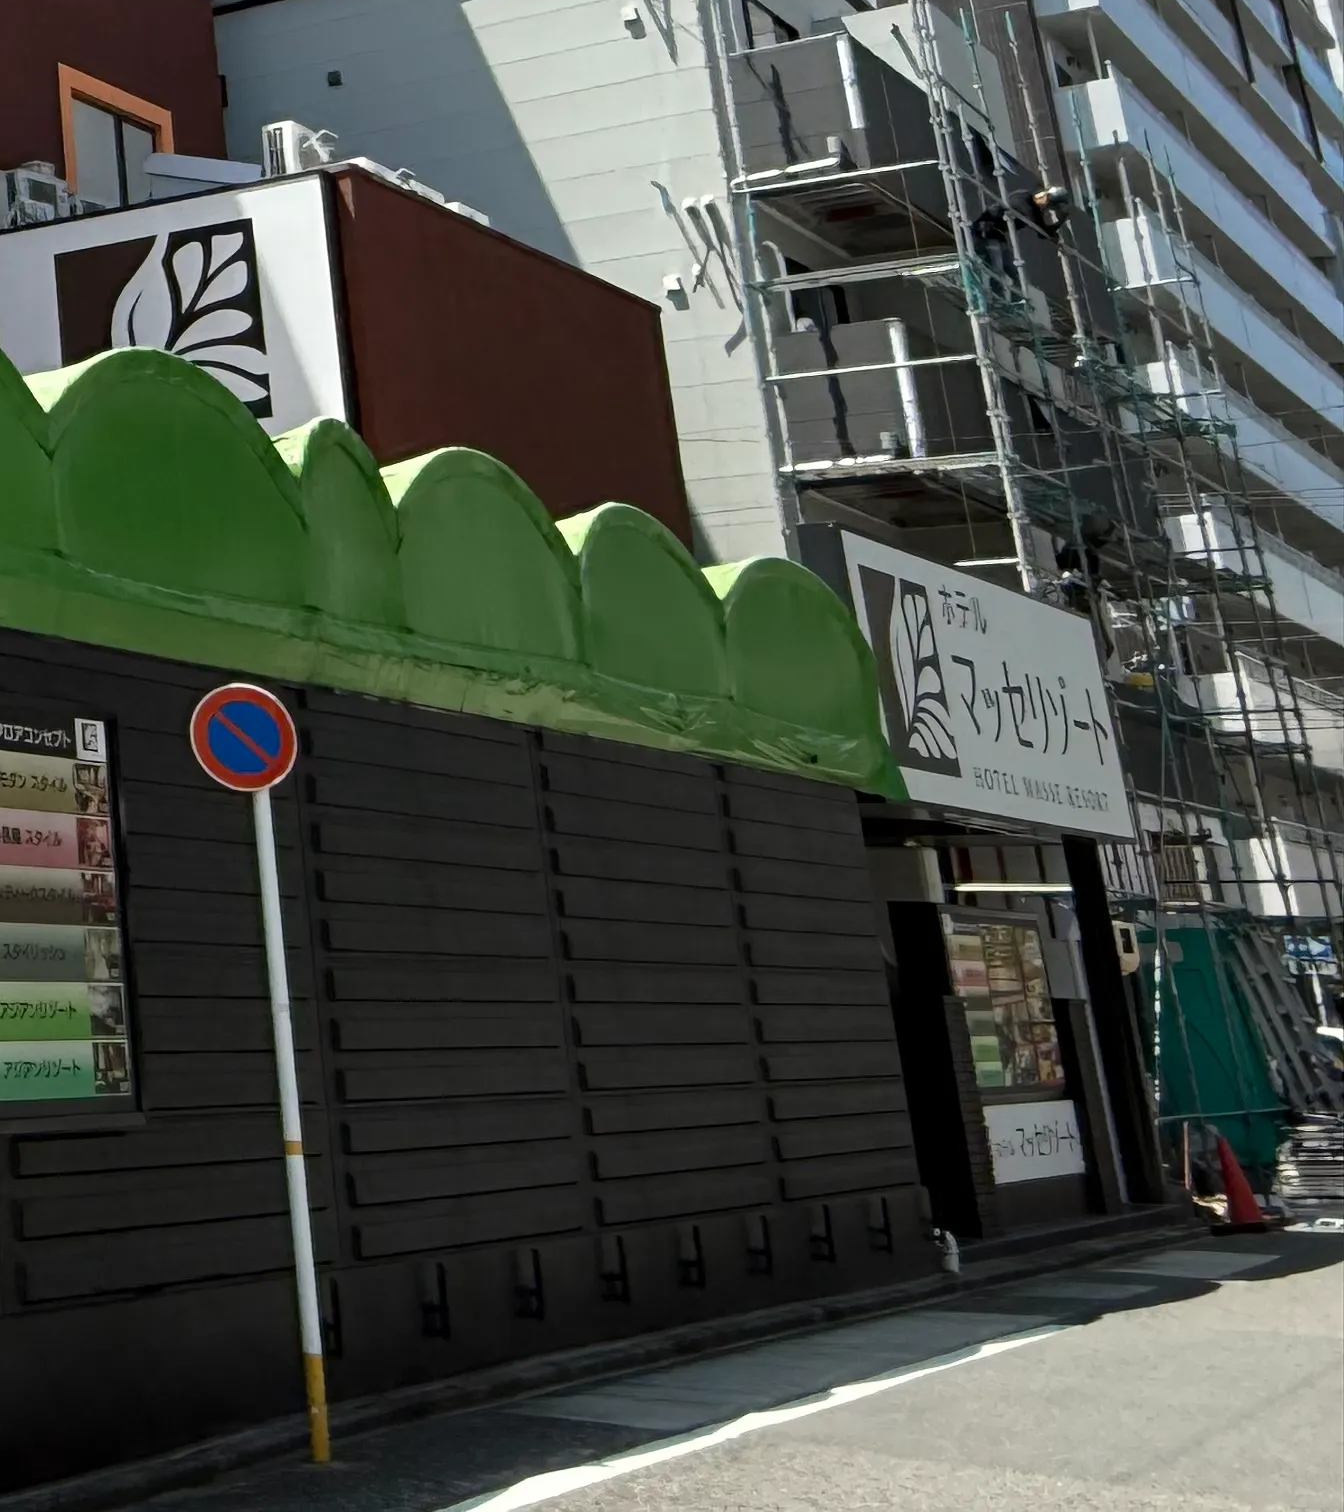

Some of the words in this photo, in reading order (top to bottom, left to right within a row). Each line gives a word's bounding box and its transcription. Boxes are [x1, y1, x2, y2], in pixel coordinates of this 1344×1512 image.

[938, 584, 987, 634] ホテル
[951, 654, 1108, 765] マッセリゾート
[973, 767, 1019, 796] HOTEL
